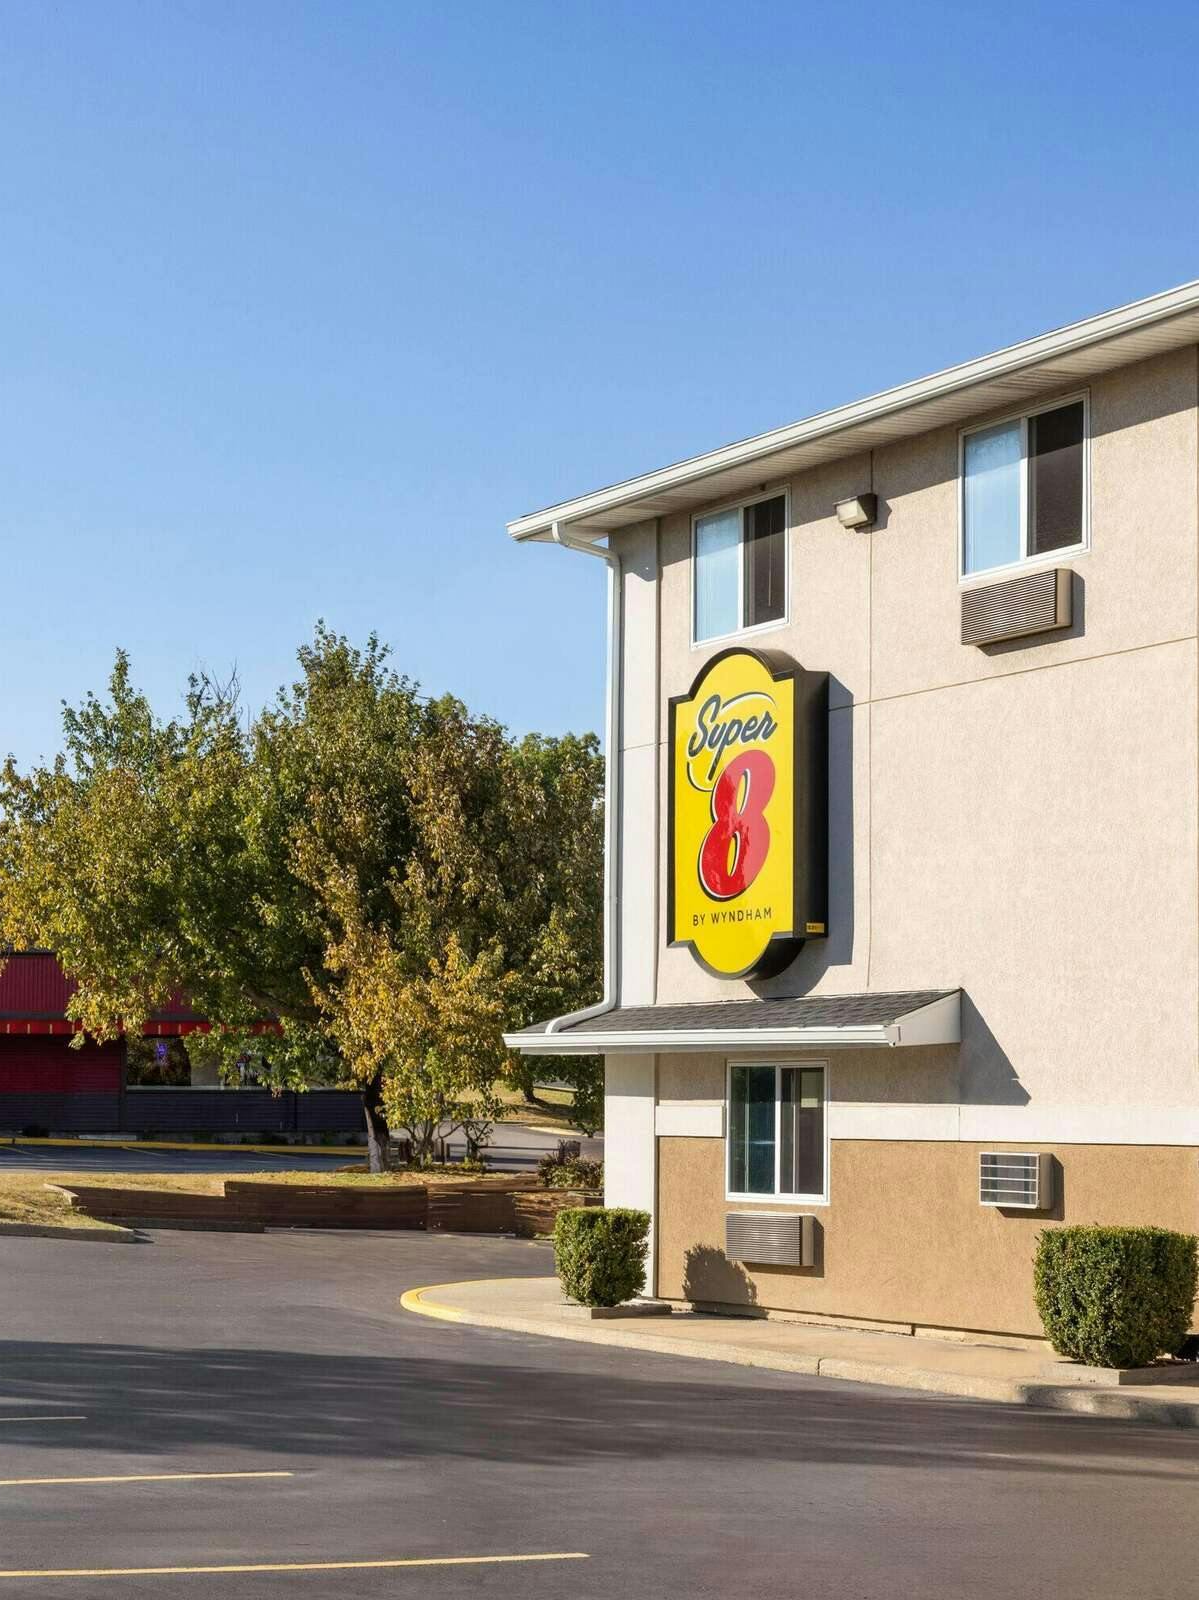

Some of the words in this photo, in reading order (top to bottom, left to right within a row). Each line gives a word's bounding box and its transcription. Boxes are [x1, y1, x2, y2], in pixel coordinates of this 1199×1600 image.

[686, 693, 778, 782] Super
[697, 748, 776, 903] 8
[692, 913, 706, 927] BY
[711, 907, 772, 925] WYNDHAM
